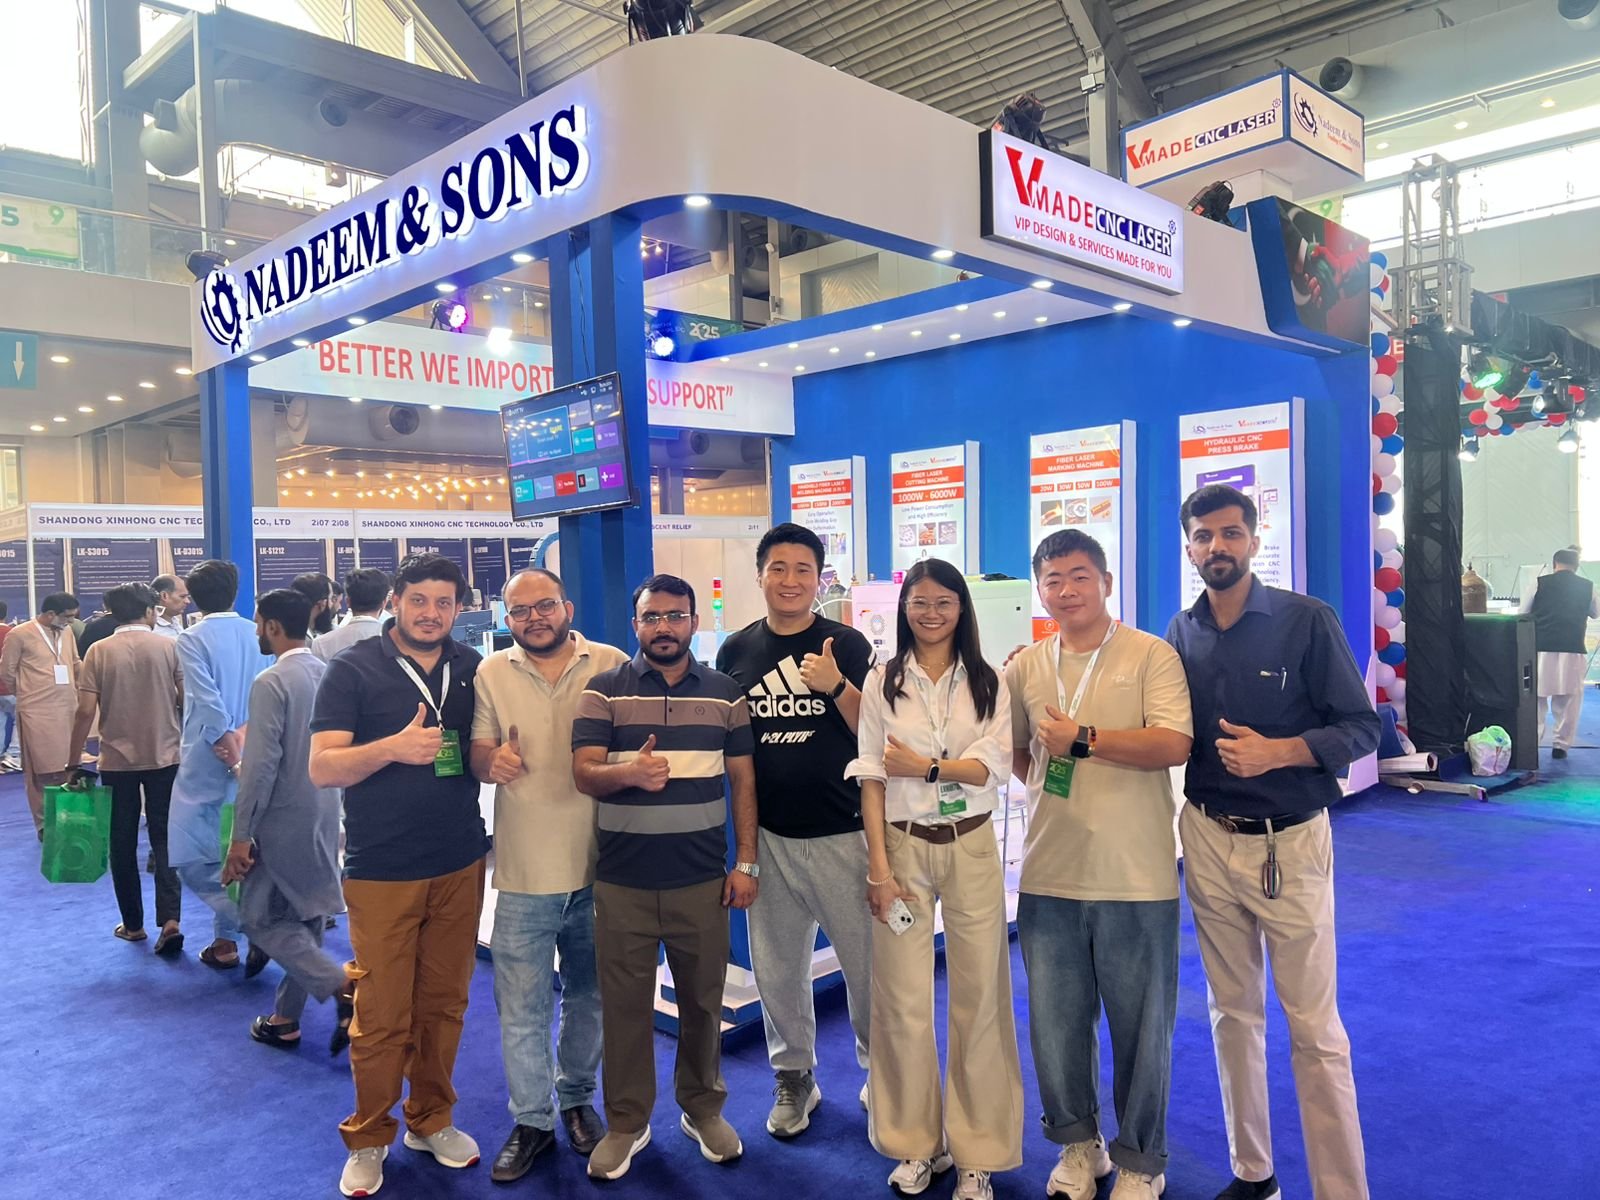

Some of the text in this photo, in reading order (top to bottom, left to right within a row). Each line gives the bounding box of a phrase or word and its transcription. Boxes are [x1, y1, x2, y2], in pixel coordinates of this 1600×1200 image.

[1195, 127, 1225, 148] CNC
[1227, 110, 1275, 137] LASER
[244, 104, 581, 321] NADEEM & SONS
[1096, 208, 1127, 240] CNC
[1128, 220, 1172, 256] LASER
[1014, 215, 1172, 279] VIP DESIGN & SERVICES MADE FOR YOU
[420, 351, 460, 385] WE
[1204, 433, 1263, 446] HYDRAULIC CNC
[1208, 443, 1259, 454] PRESS BRAKE
[1075, 454, 1095, 462] LASER
[1047, 461, 1104, 472] MARKING MACHINE
[898, 492, 924, 502] 1000W
[929, 489, 957, 500] 6000W
[38, 515, 103, 525] SHANDONG
[106, 516, 156, 525] XINHONG
[159, 517, 181, 525] CNC
[274, 518, 291, 526] LTD
